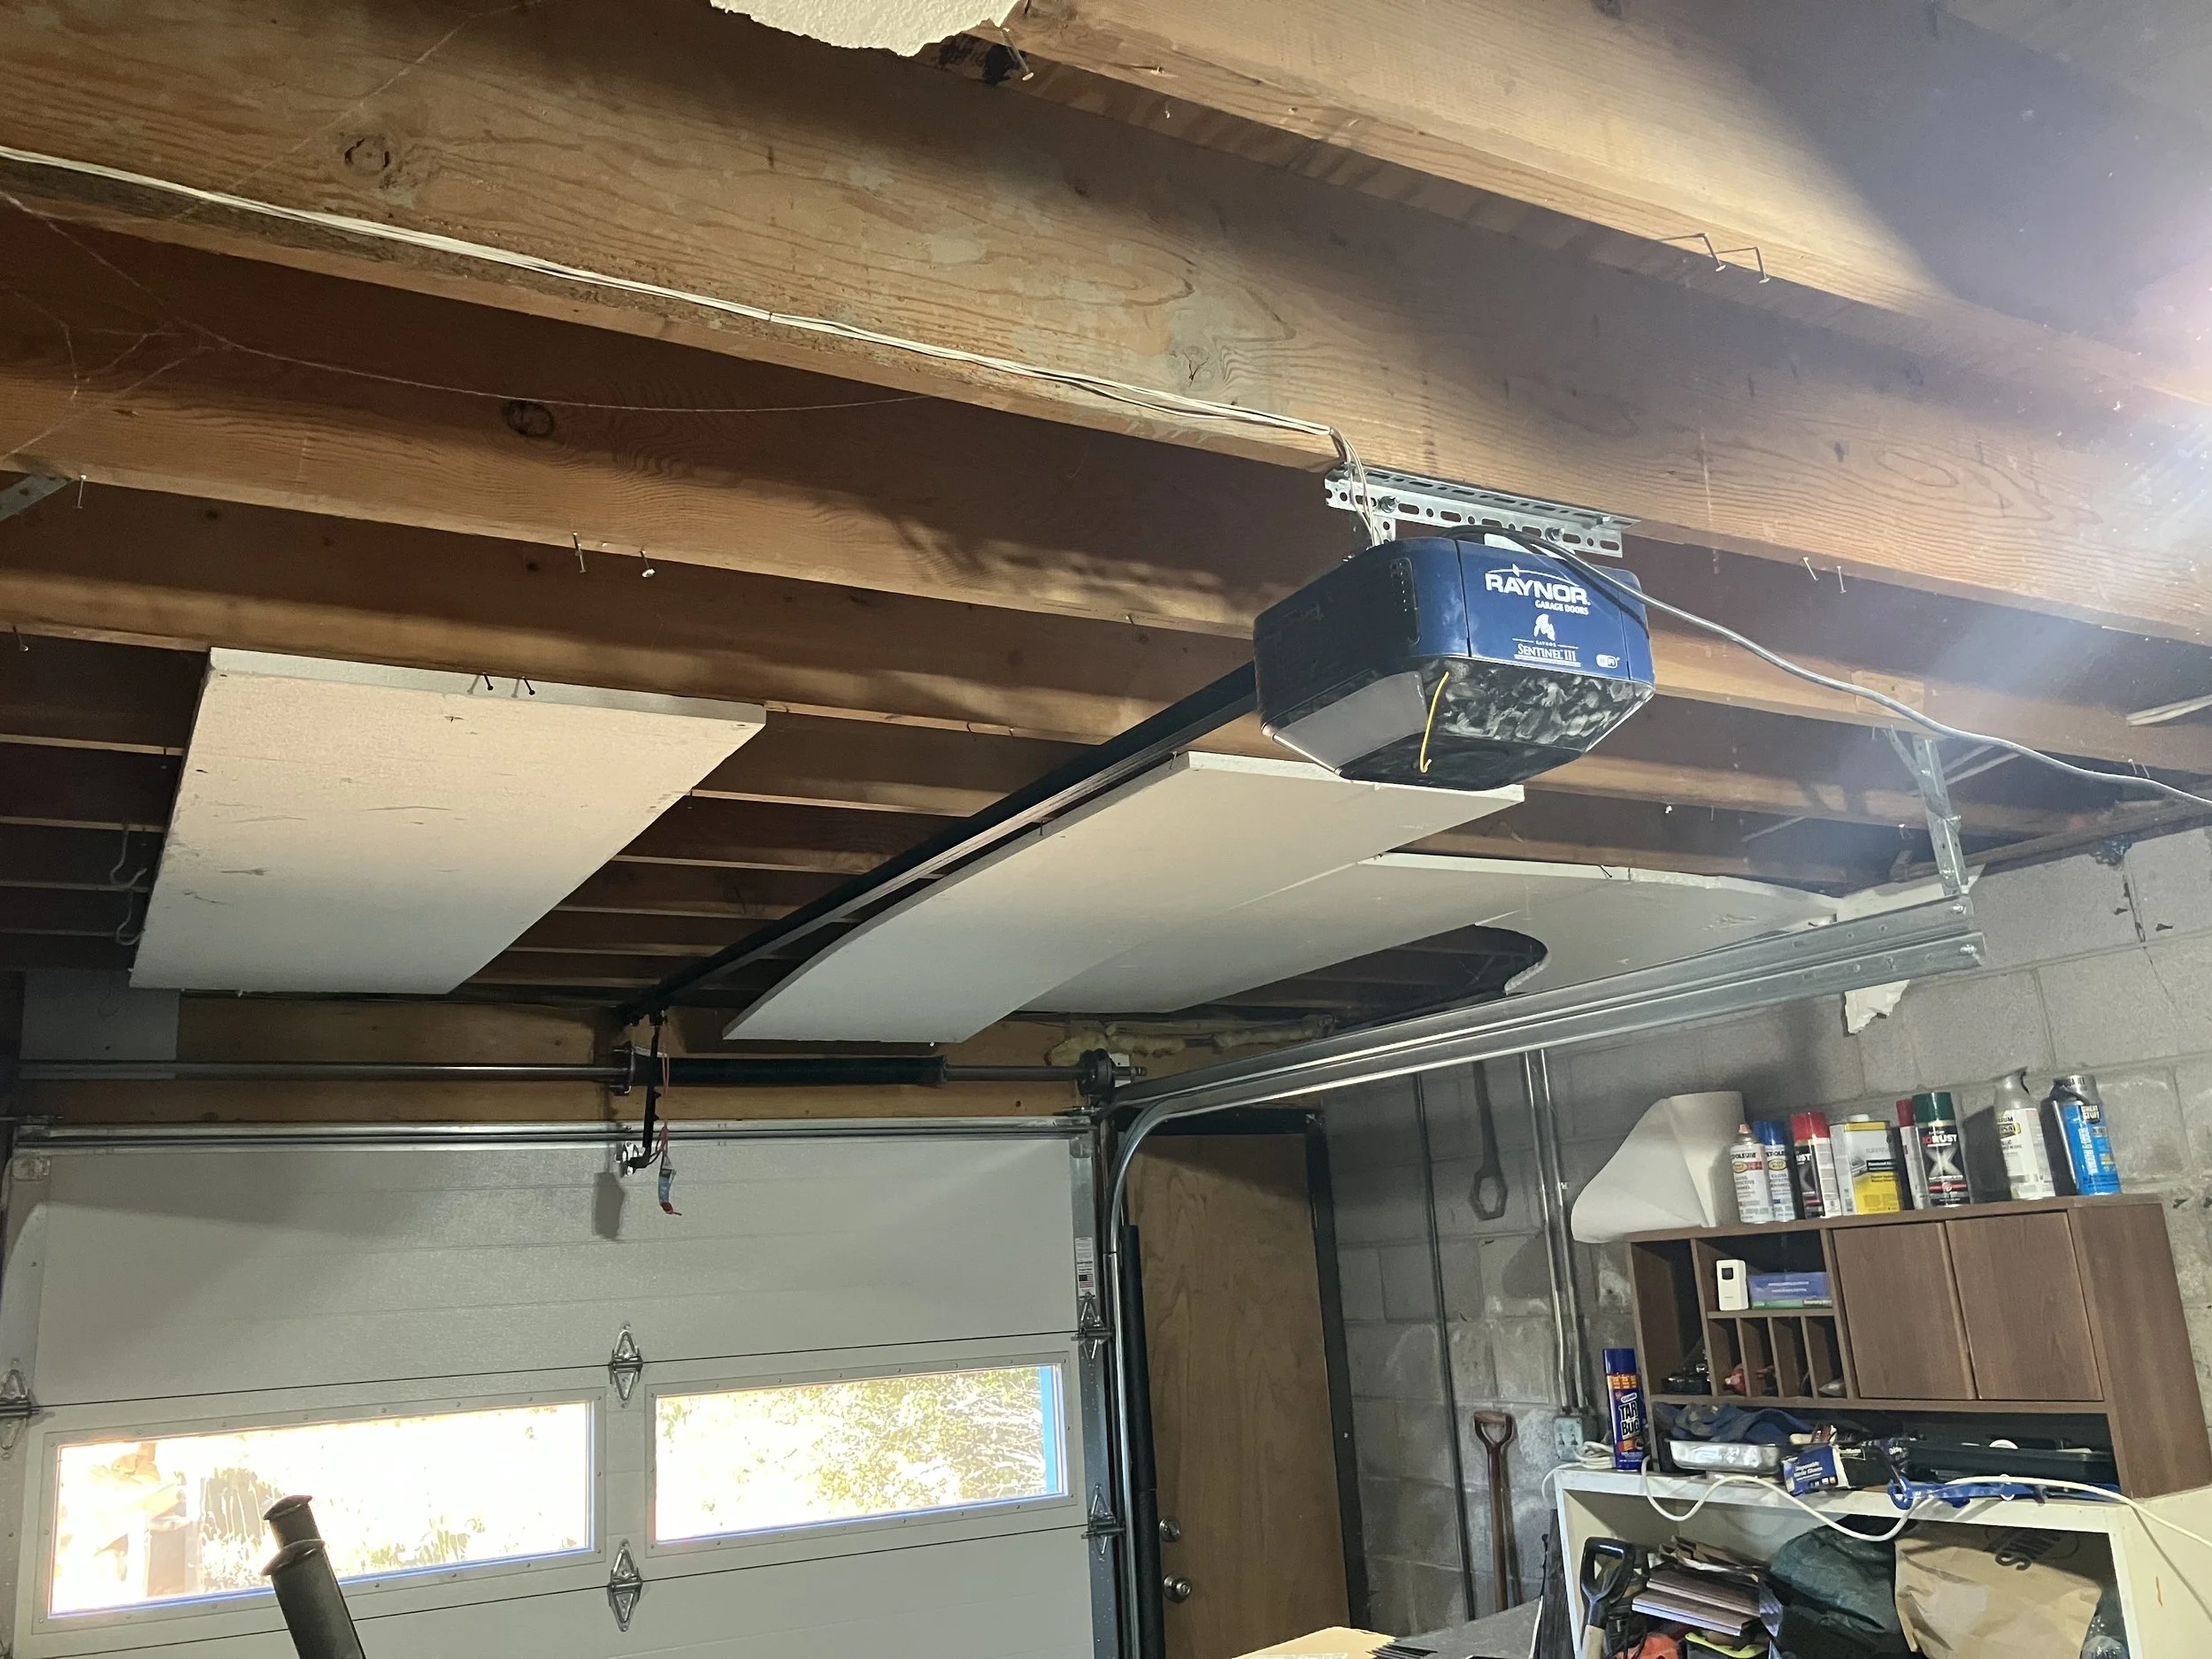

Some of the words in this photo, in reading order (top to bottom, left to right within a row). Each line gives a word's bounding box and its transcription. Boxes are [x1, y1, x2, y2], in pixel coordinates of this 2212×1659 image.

[1485, 572, 1588, 606] RAYNOR
[1534, 599, 1563, 612] GARAGE
[1563, 603, 1589, 616] DOORS
[1517, 642, 1563, 660] SENTINEL
[1563, 649, 1578, 662] III
[1932, 1133, 1958, 1143] RUST
[1795, 1153, 1812, 1162] UST
[1619, 1402, 1638, 1421] TAR
[1621, 1419, 1640, 1436] BUG
